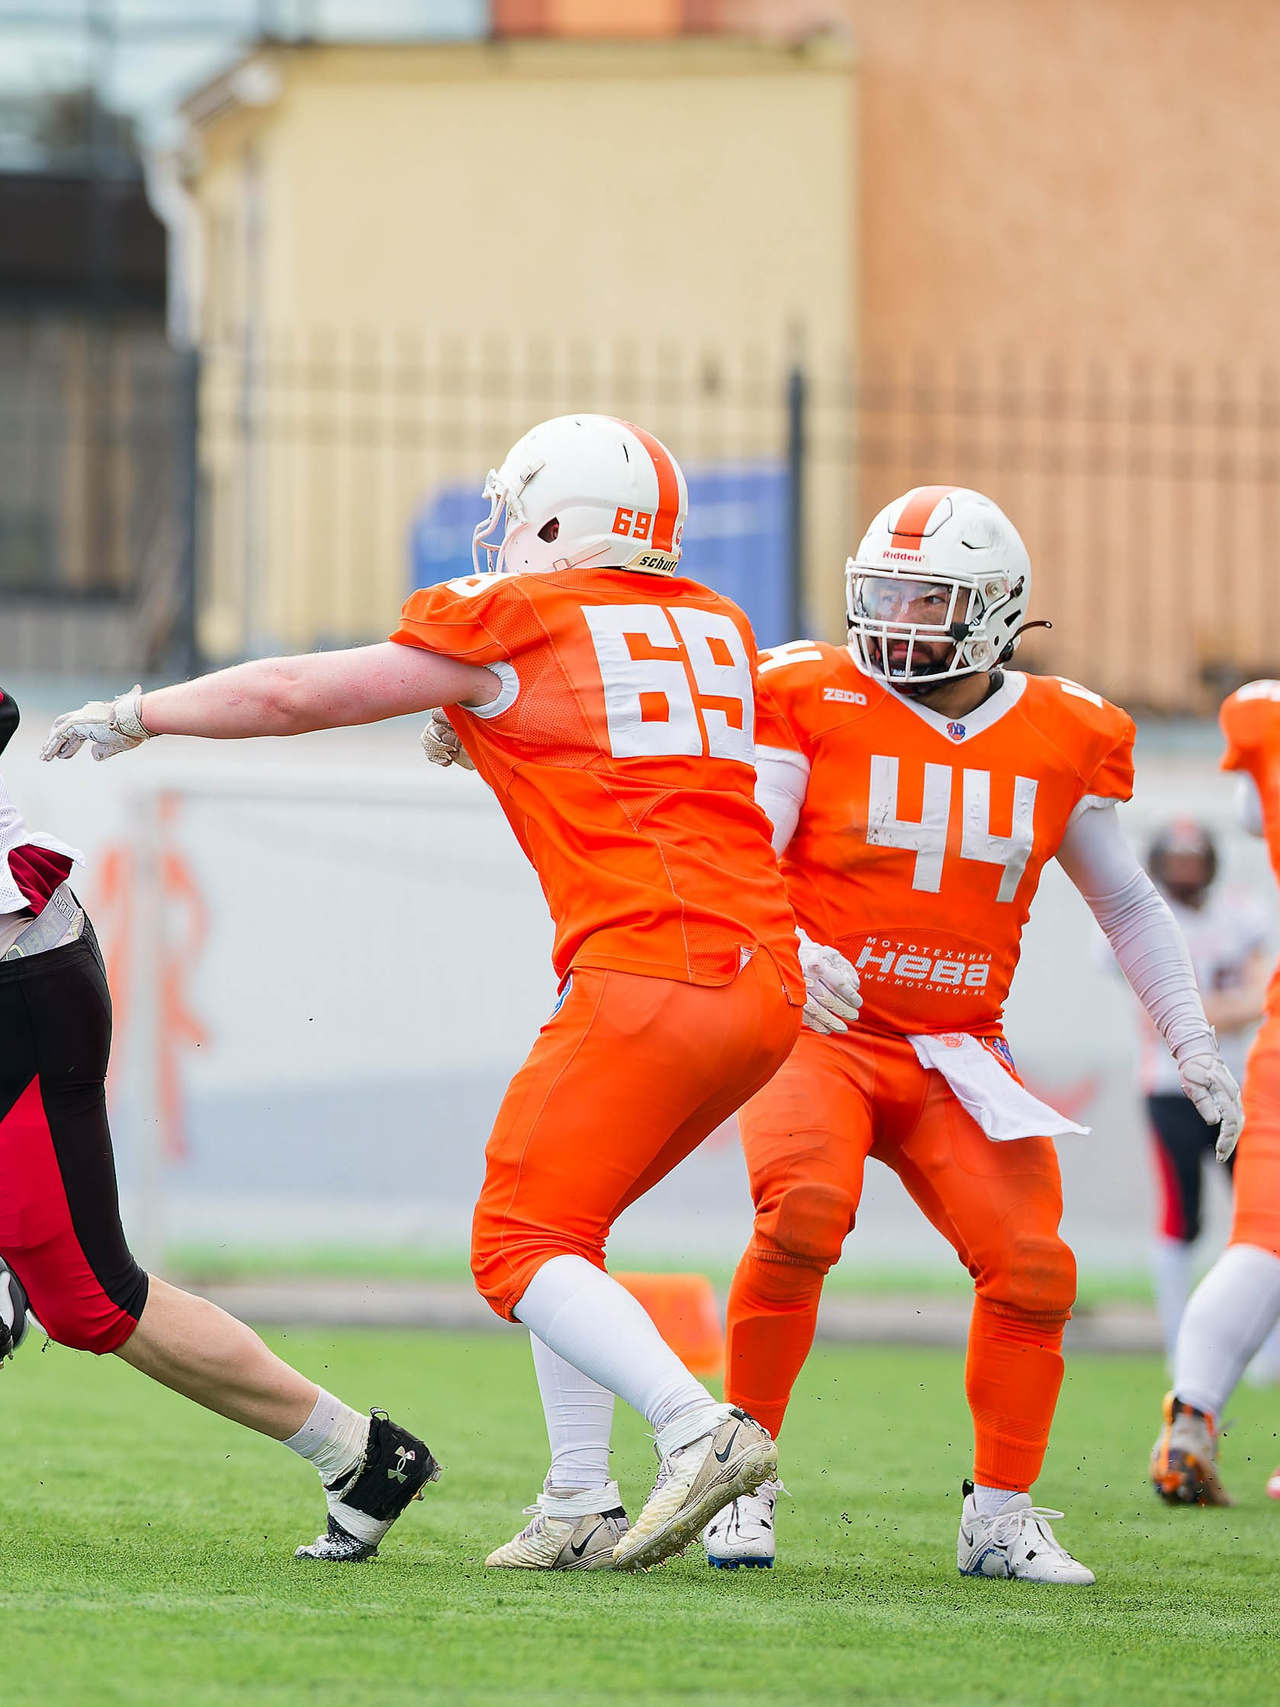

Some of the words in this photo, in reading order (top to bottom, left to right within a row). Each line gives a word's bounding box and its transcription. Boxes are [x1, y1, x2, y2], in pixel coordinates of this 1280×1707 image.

[612, 507, 652, 541] 69
[883, 550, 925, 562] Riddell
[580, 604, 756, 766] 69
[823, 687, 867, 706] ZEDO
[866, 754, 1039, 903] 44
[866, 936, 993, 962] МОТОТЕХНИКА
[857, 971, 985, 996] WW.MOTOBLOK.RU
